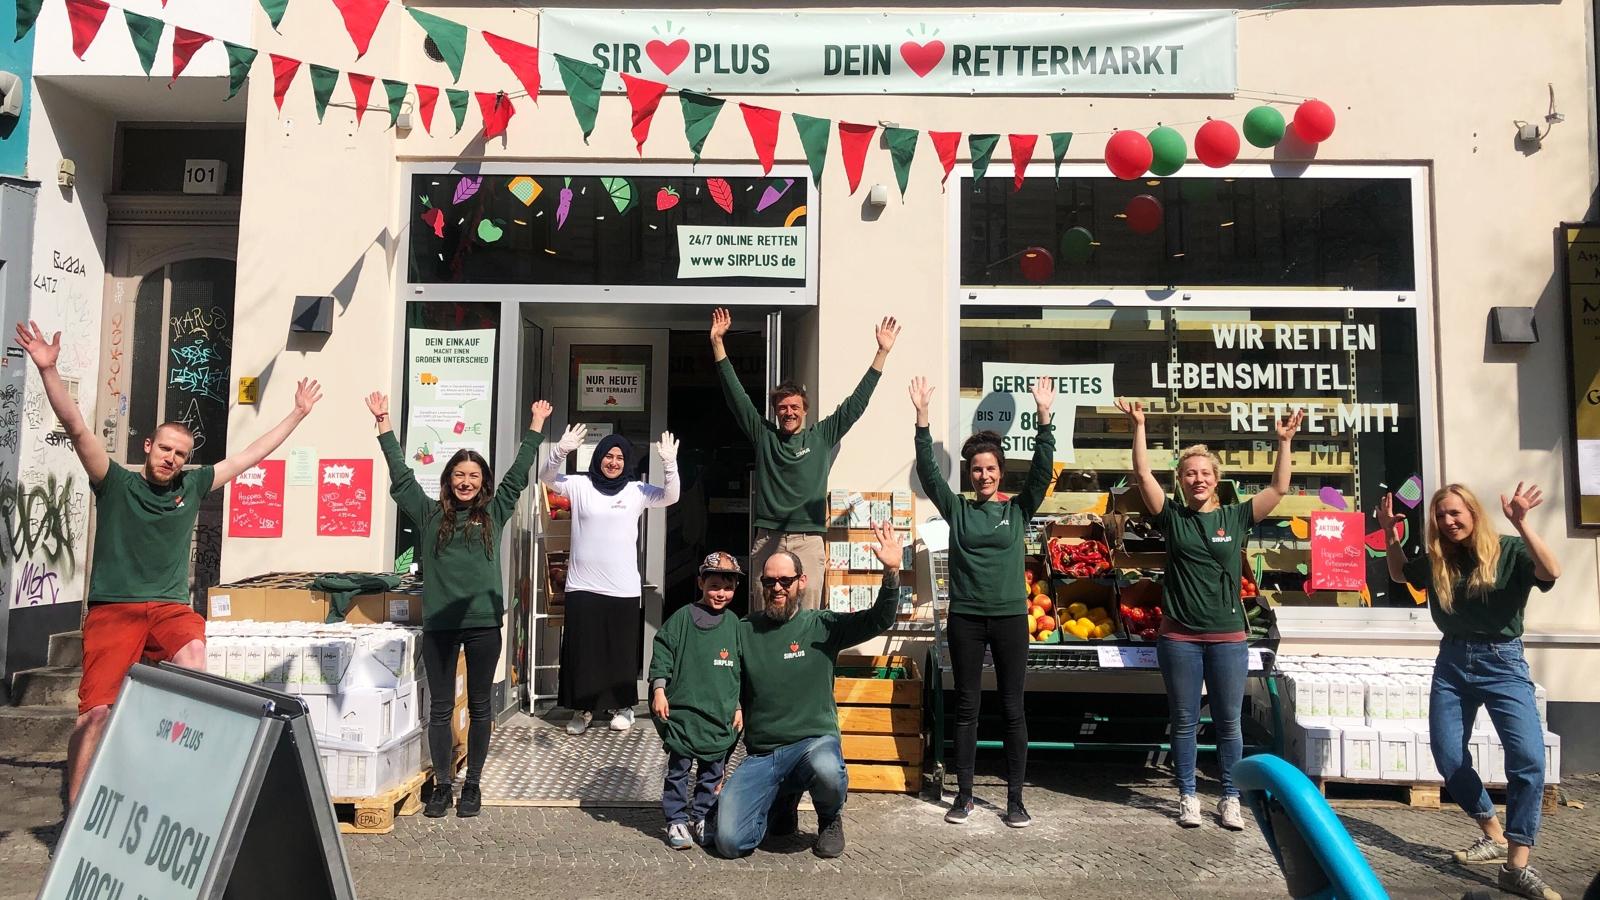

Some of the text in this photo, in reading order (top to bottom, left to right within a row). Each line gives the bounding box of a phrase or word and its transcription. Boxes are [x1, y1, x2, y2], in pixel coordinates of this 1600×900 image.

[593, 43, 1184, 76] SIR PLUS DEIN RETTERMARKT
[186, 167, 215, 183] 101
[689, 234, 798, 246] 24/7 ONLINE RETTEN
[727, 254, 778, 267] SIRPLUS
[425, 338, 481, 346] DEIN EINKAUF
[1212, 323, 1376, 351] WIR RETTEN
[586, 375, 638, 385] NUR HEUTE
[1151, 362, 1355, 390] LEBENSMITTEL.
[977, 411, 993, 421] BIS
[998, 411, 1011, 421] ZU
[1230, 402, 1325, 433] RETTE
[1338, 402, 1399, 433] MIT!
[156, 718, 204, 751] SIR PLUS
[360, 815, 378, 825] EPAL
[84, 784, 210, 890] DIT IS DOCH
